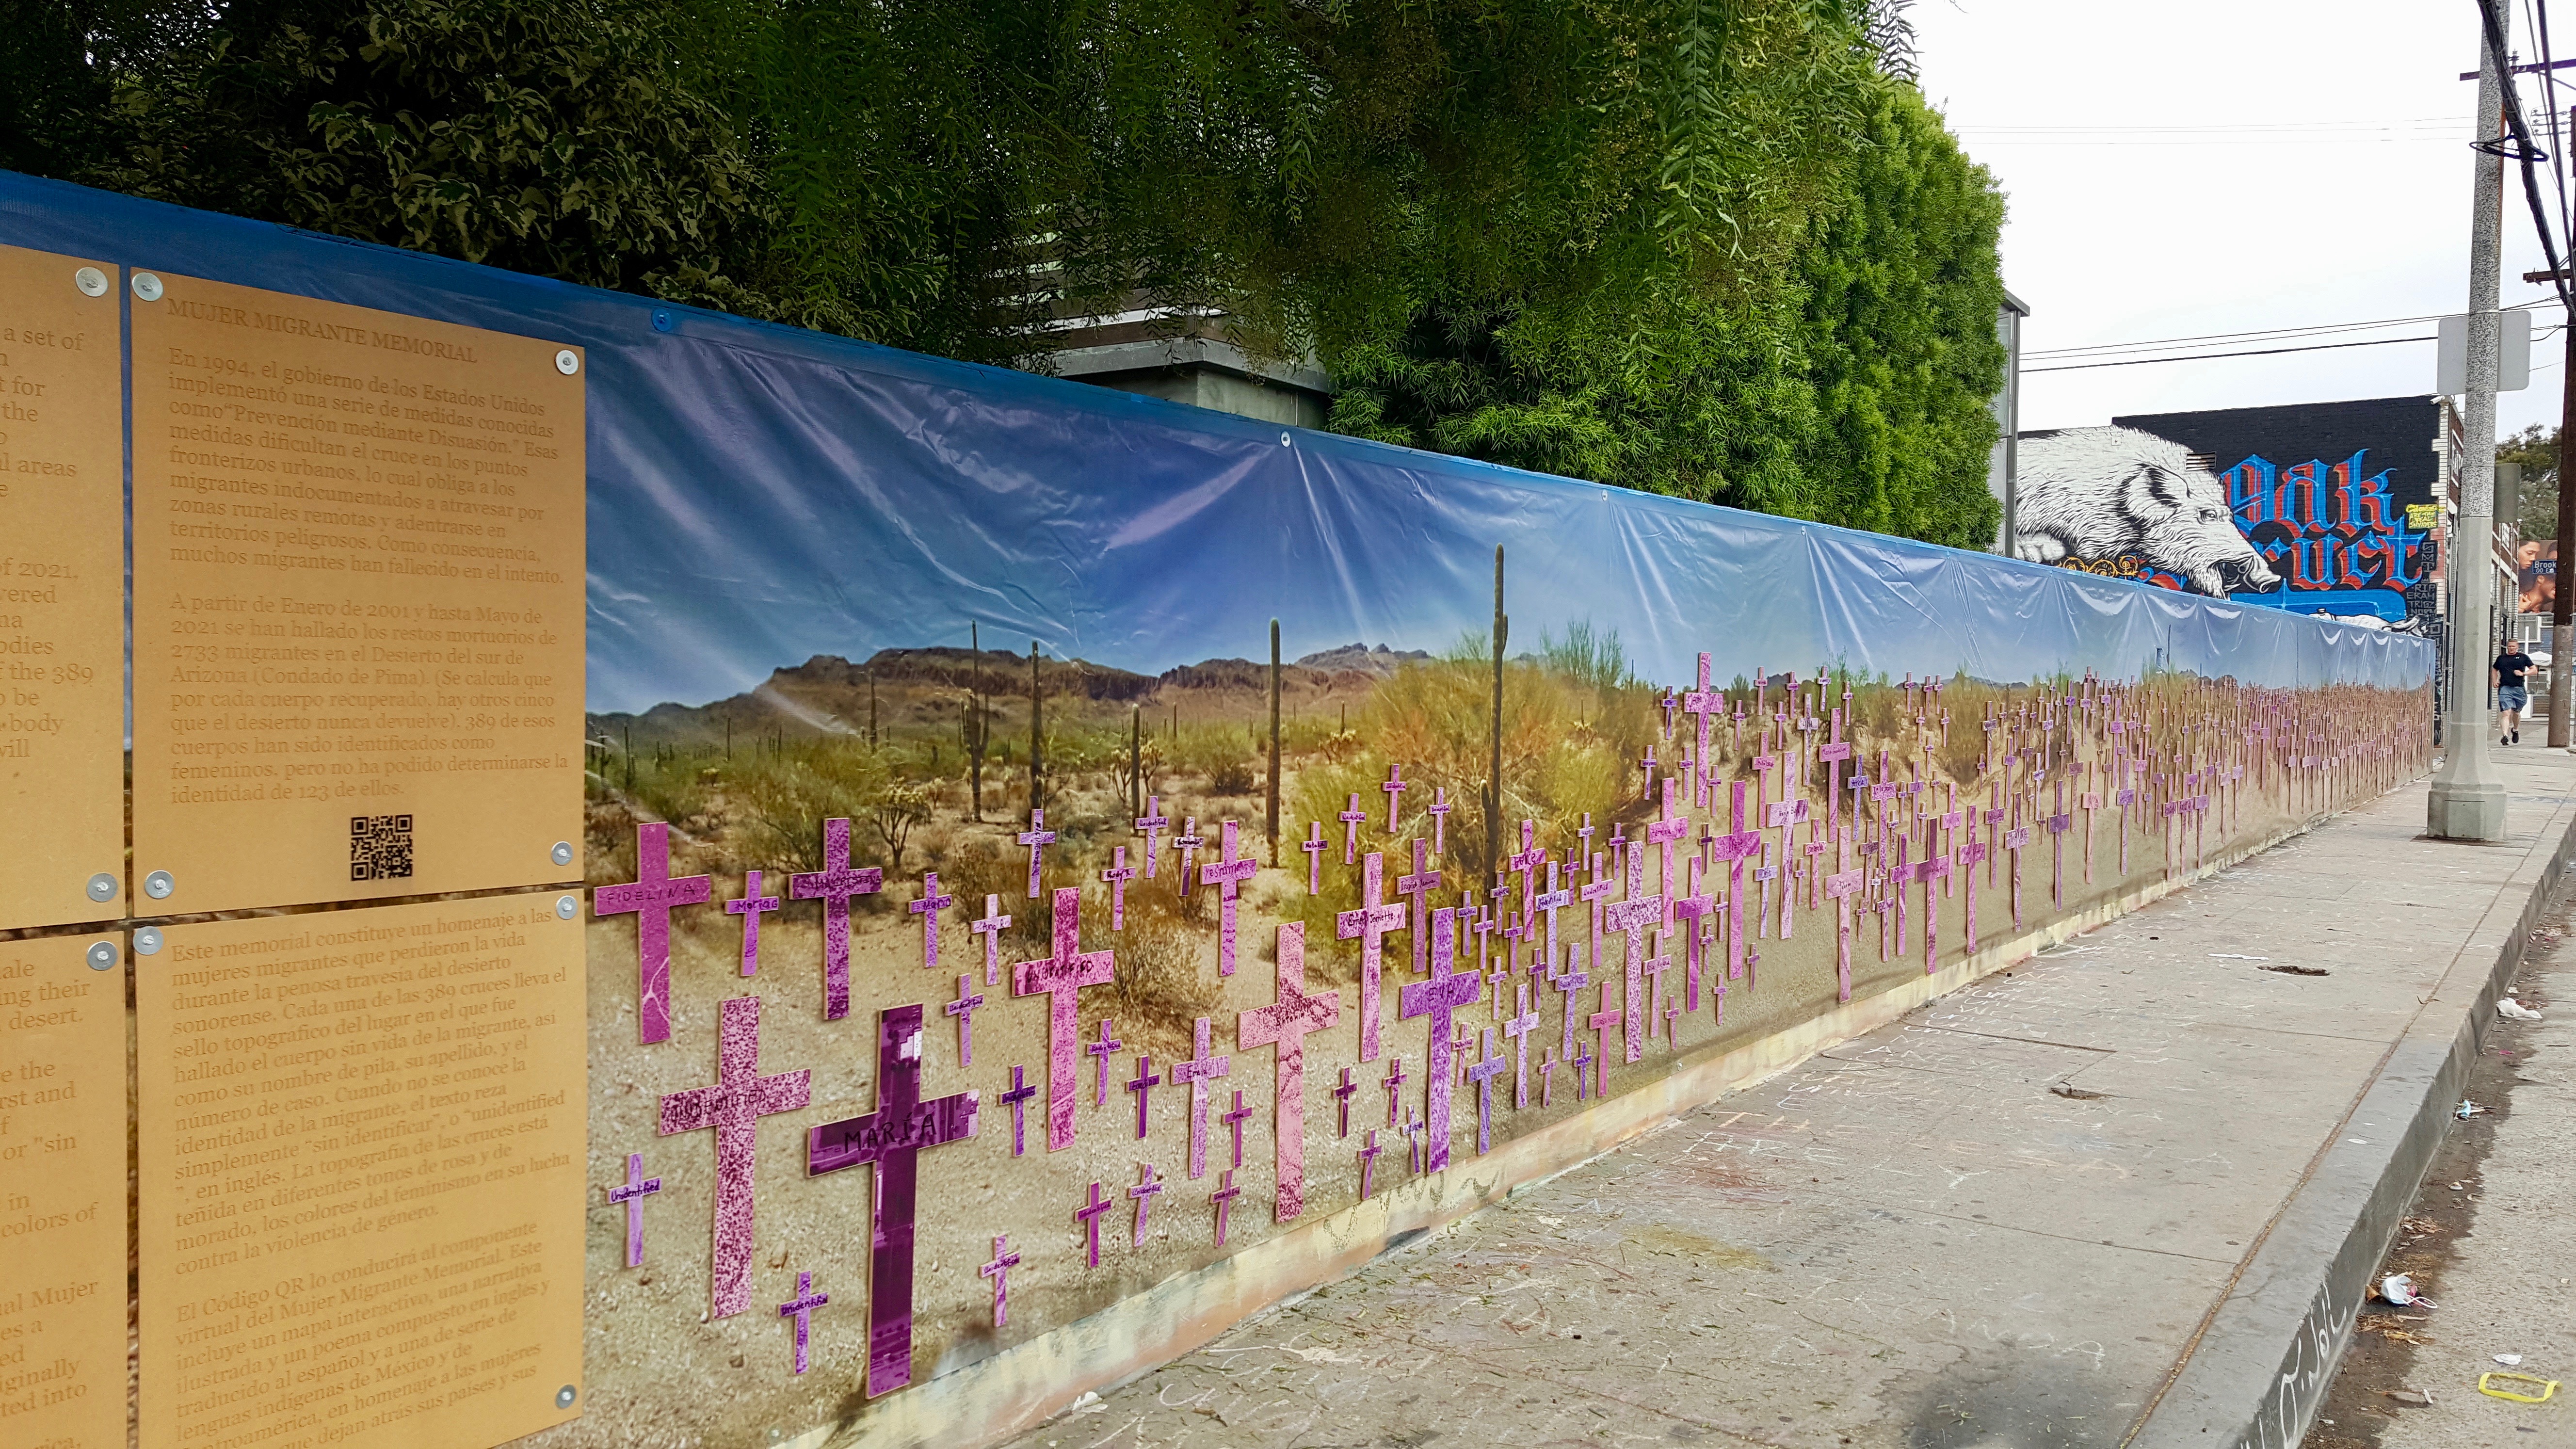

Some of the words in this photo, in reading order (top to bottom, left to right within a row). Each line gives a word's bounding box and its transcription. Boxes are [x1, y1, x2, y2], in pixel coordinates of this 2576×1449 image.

[4, 327, 16, 341] a
[23, 330, 55, 347] set
[62, 332, 85, 351] of
[167, 298, 249, 328] MUJER
[254, 312, 367, 347] MIGRANTE
[372, 332, 477, 364] MEMORIAL
[13, 375, 46, 397] for
[169, 346, 196, 368] En
[261, 361, 277, 379] el
[283, 367, 363, 391] gobierno
[368, 375, 389, 395] de
[391, 379, 417, 399] los
[423, 384, 485, 408] Estados
[491, 394, 544, 416] Unidos
[1, 401, 38, 422] the
[169, 371, 287, 403] implementó
[293, 393, 327, 409] una
[332, 398, 374, 415] serie
[379, 400, 399, 418] de
[404, 406, 473, 428] medidas
[478, 418, 553, 438] conocidas
[169, 424, 253, 447] medidas
[258, 431, 346, 457] dificultan
[352, 443, 366, 459] el
[372, 449, 418, 465] cruce
[422, 454, 441, 467] en
[447, 452, 469, 470] los
[474, 460, 527, 477] puntos
[343, 421, 423, 444] mediante
[525, 441, 558, 460] Esas
[18, 459, 77, 477] areas
[169, 445, 276, 473] fronterizos
[366, 466, 382, 483] lo
[387, 471, 420, 487] cual
[426, 473, 475, 496] obliga
[494, 479, 515, 497] los
[170, 472, 268, 496] migrantes
[274, 480, 421, 509] indocumentados
[440, 499, 513, 517] atravesar
[517, 507, 544, 523] por
[11, 661, 47, 680] the
[13, 687, 40, 707] be
[8, 713, 64, 736] body
[607, 884, 695, 905] FIDELINA
[172, 944, 213, 963] Este
[220, 932, 310, 957] memorial
[316, 926, 405, 947] constituye
[411, 924, 432, 937] un
[437, 912, 514, 934] homenaje
[531, 909, 552, 924] las
[172, 966, 250, 988] mujeres
[257, 955, 348, 979] migrantes
[353, 950, 385, 970] que
[390, 941, 470, 966] perdieron
[475, 935, 488, 951] la
[493, 932, 525, 949] vida
[38, 979, 91, 1001] their
[172, 988, 250, 1011] durante
[256, 983, 271, 1000] la
[277, 978, 340, 1002] penosa
[346, 966, 413, 989] travesía
[418, 961, 445, 980] del
[447, 956, 510, 976] desierto
[19, 1061, 56, 1080] the
[34, 1080, 77, 1105] and
[844, 1111, 937, 1154] MARÍA
[3, 1143, 28, 1160] or
[8, 1192, 30, 1211] in
[1, 1213, 69, 1238] colors
[75, 1201, 99, 1223] of
[177, 1302, 196, 1324] El
[203, 1288, 270, 1317] Código
[274, 1275, 305, 1299] QR
[310, 1272, 326, 1290] lo
[332, 1248, 416, 1285] conducirá
[421, 1243, 436, 1262] al
[441, 1222, 537, 1257] componente
[32, 1280, 99, 1308] Mujer
[176, 1315, 240, 1348] virtual
[246, 1306, 274, 1330] del
[281, 1295, 335, 1320] Mujer
[340, 1273, 418, 1304] Migrante
[511, 1241, 541, 1260] Este
[31, 1319, 43, 1335] a
[43, 1383, 87, 1406] into
